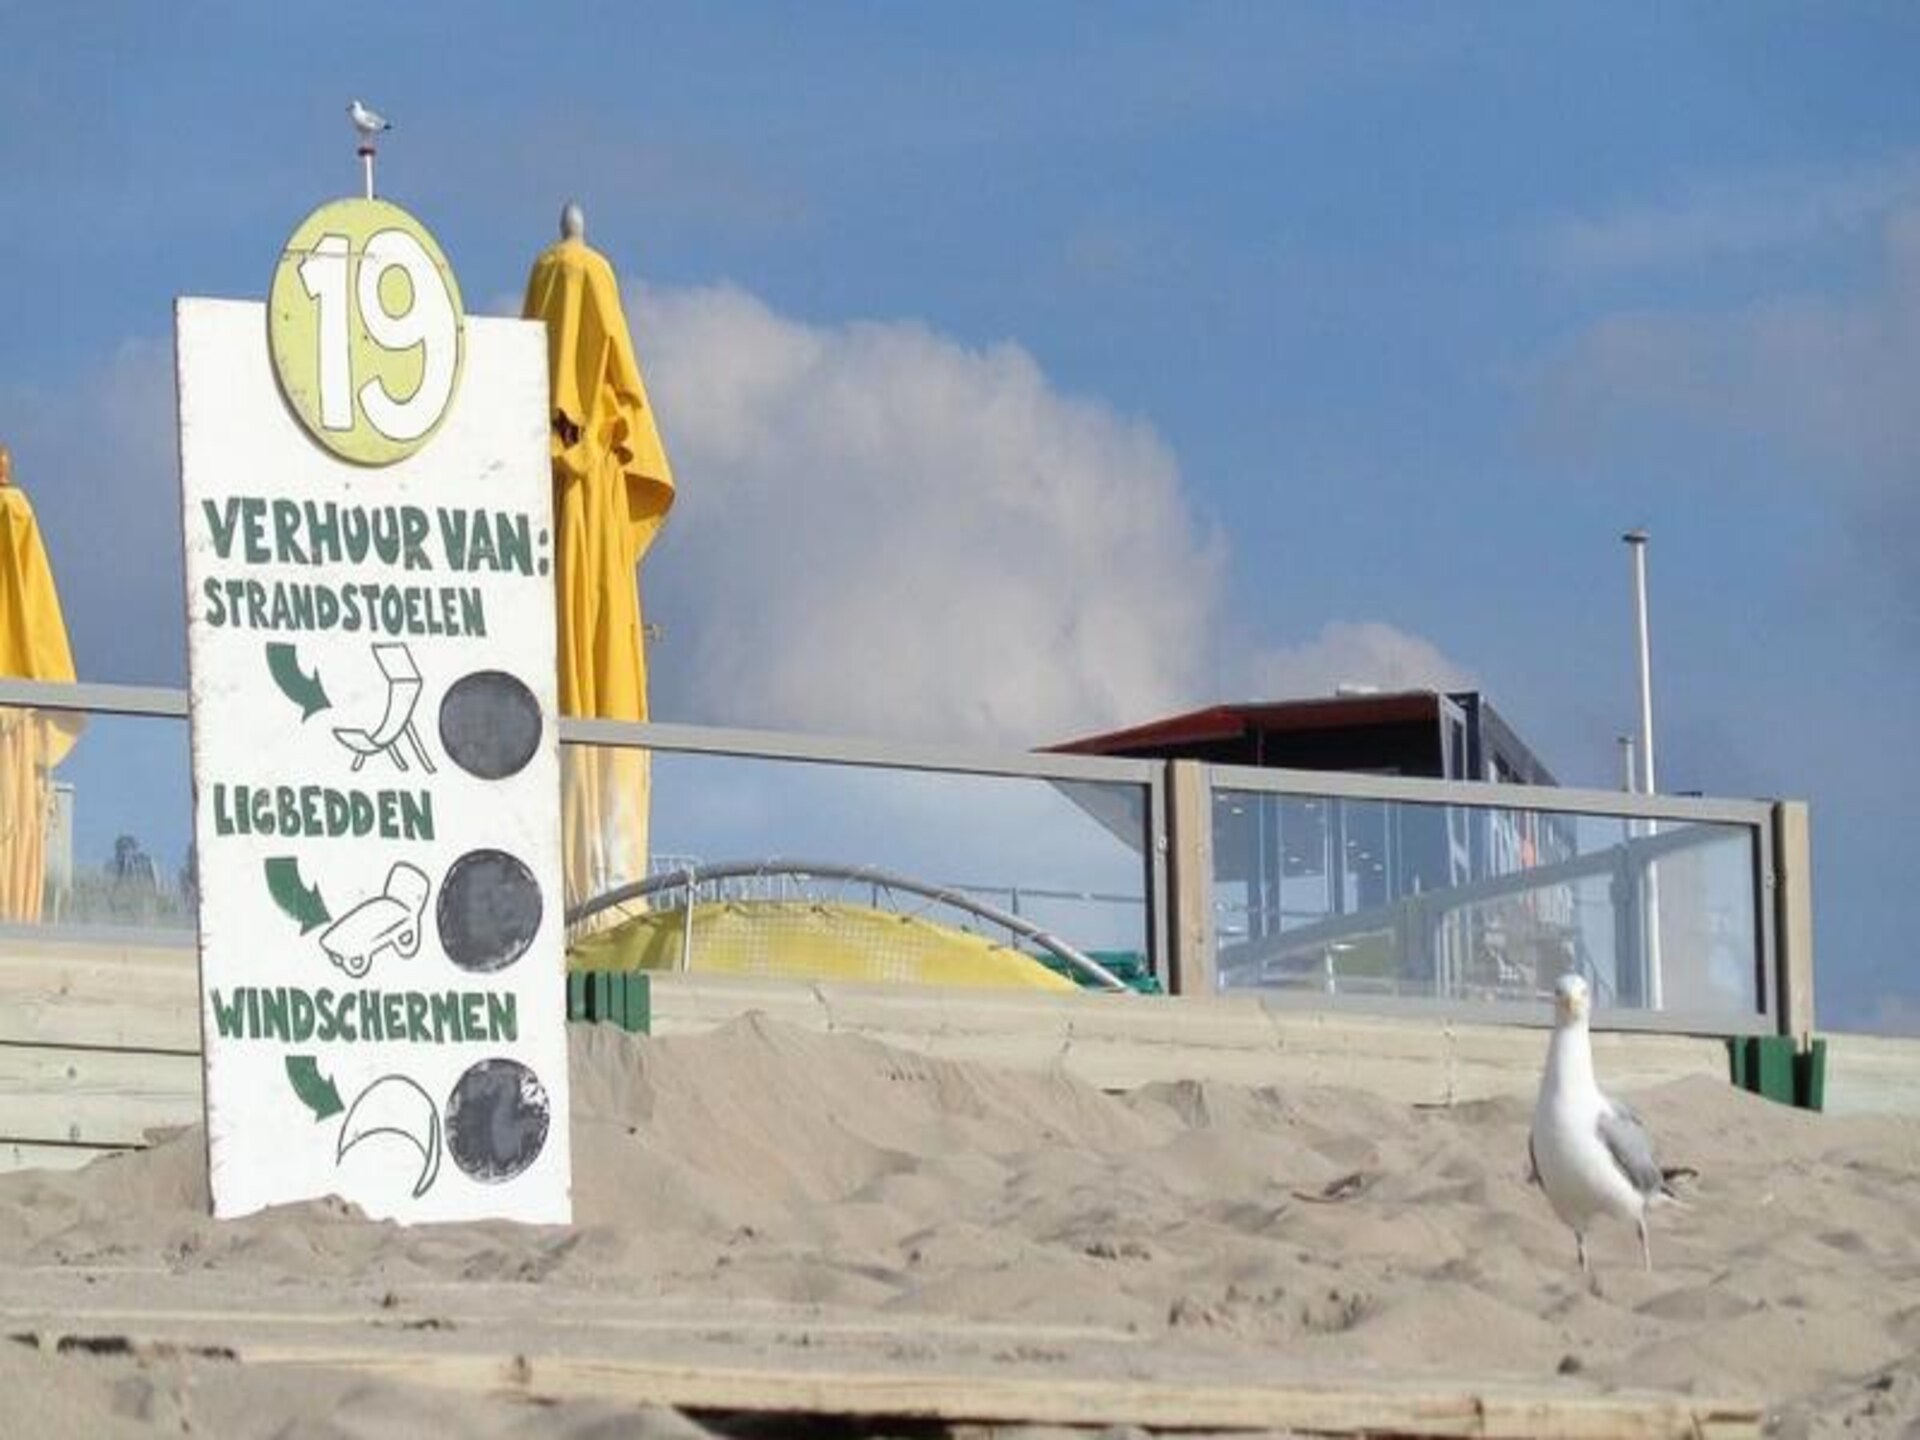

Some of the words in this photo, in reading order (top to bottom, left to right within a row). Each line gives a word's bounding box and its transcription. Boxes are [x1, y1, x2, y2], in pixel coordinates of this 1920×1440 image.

[298, 228, 460, 441] 19
[201, 497, 432, 570] VERHUUR
[437, 507, 549, 576] VAN:
[203, 577, 487, 637] STRANDSTOELEN
[213, 783, 435, 841] LIGBEDDEN
[210, 987, 518, 1043] WINDSCHERMEN
